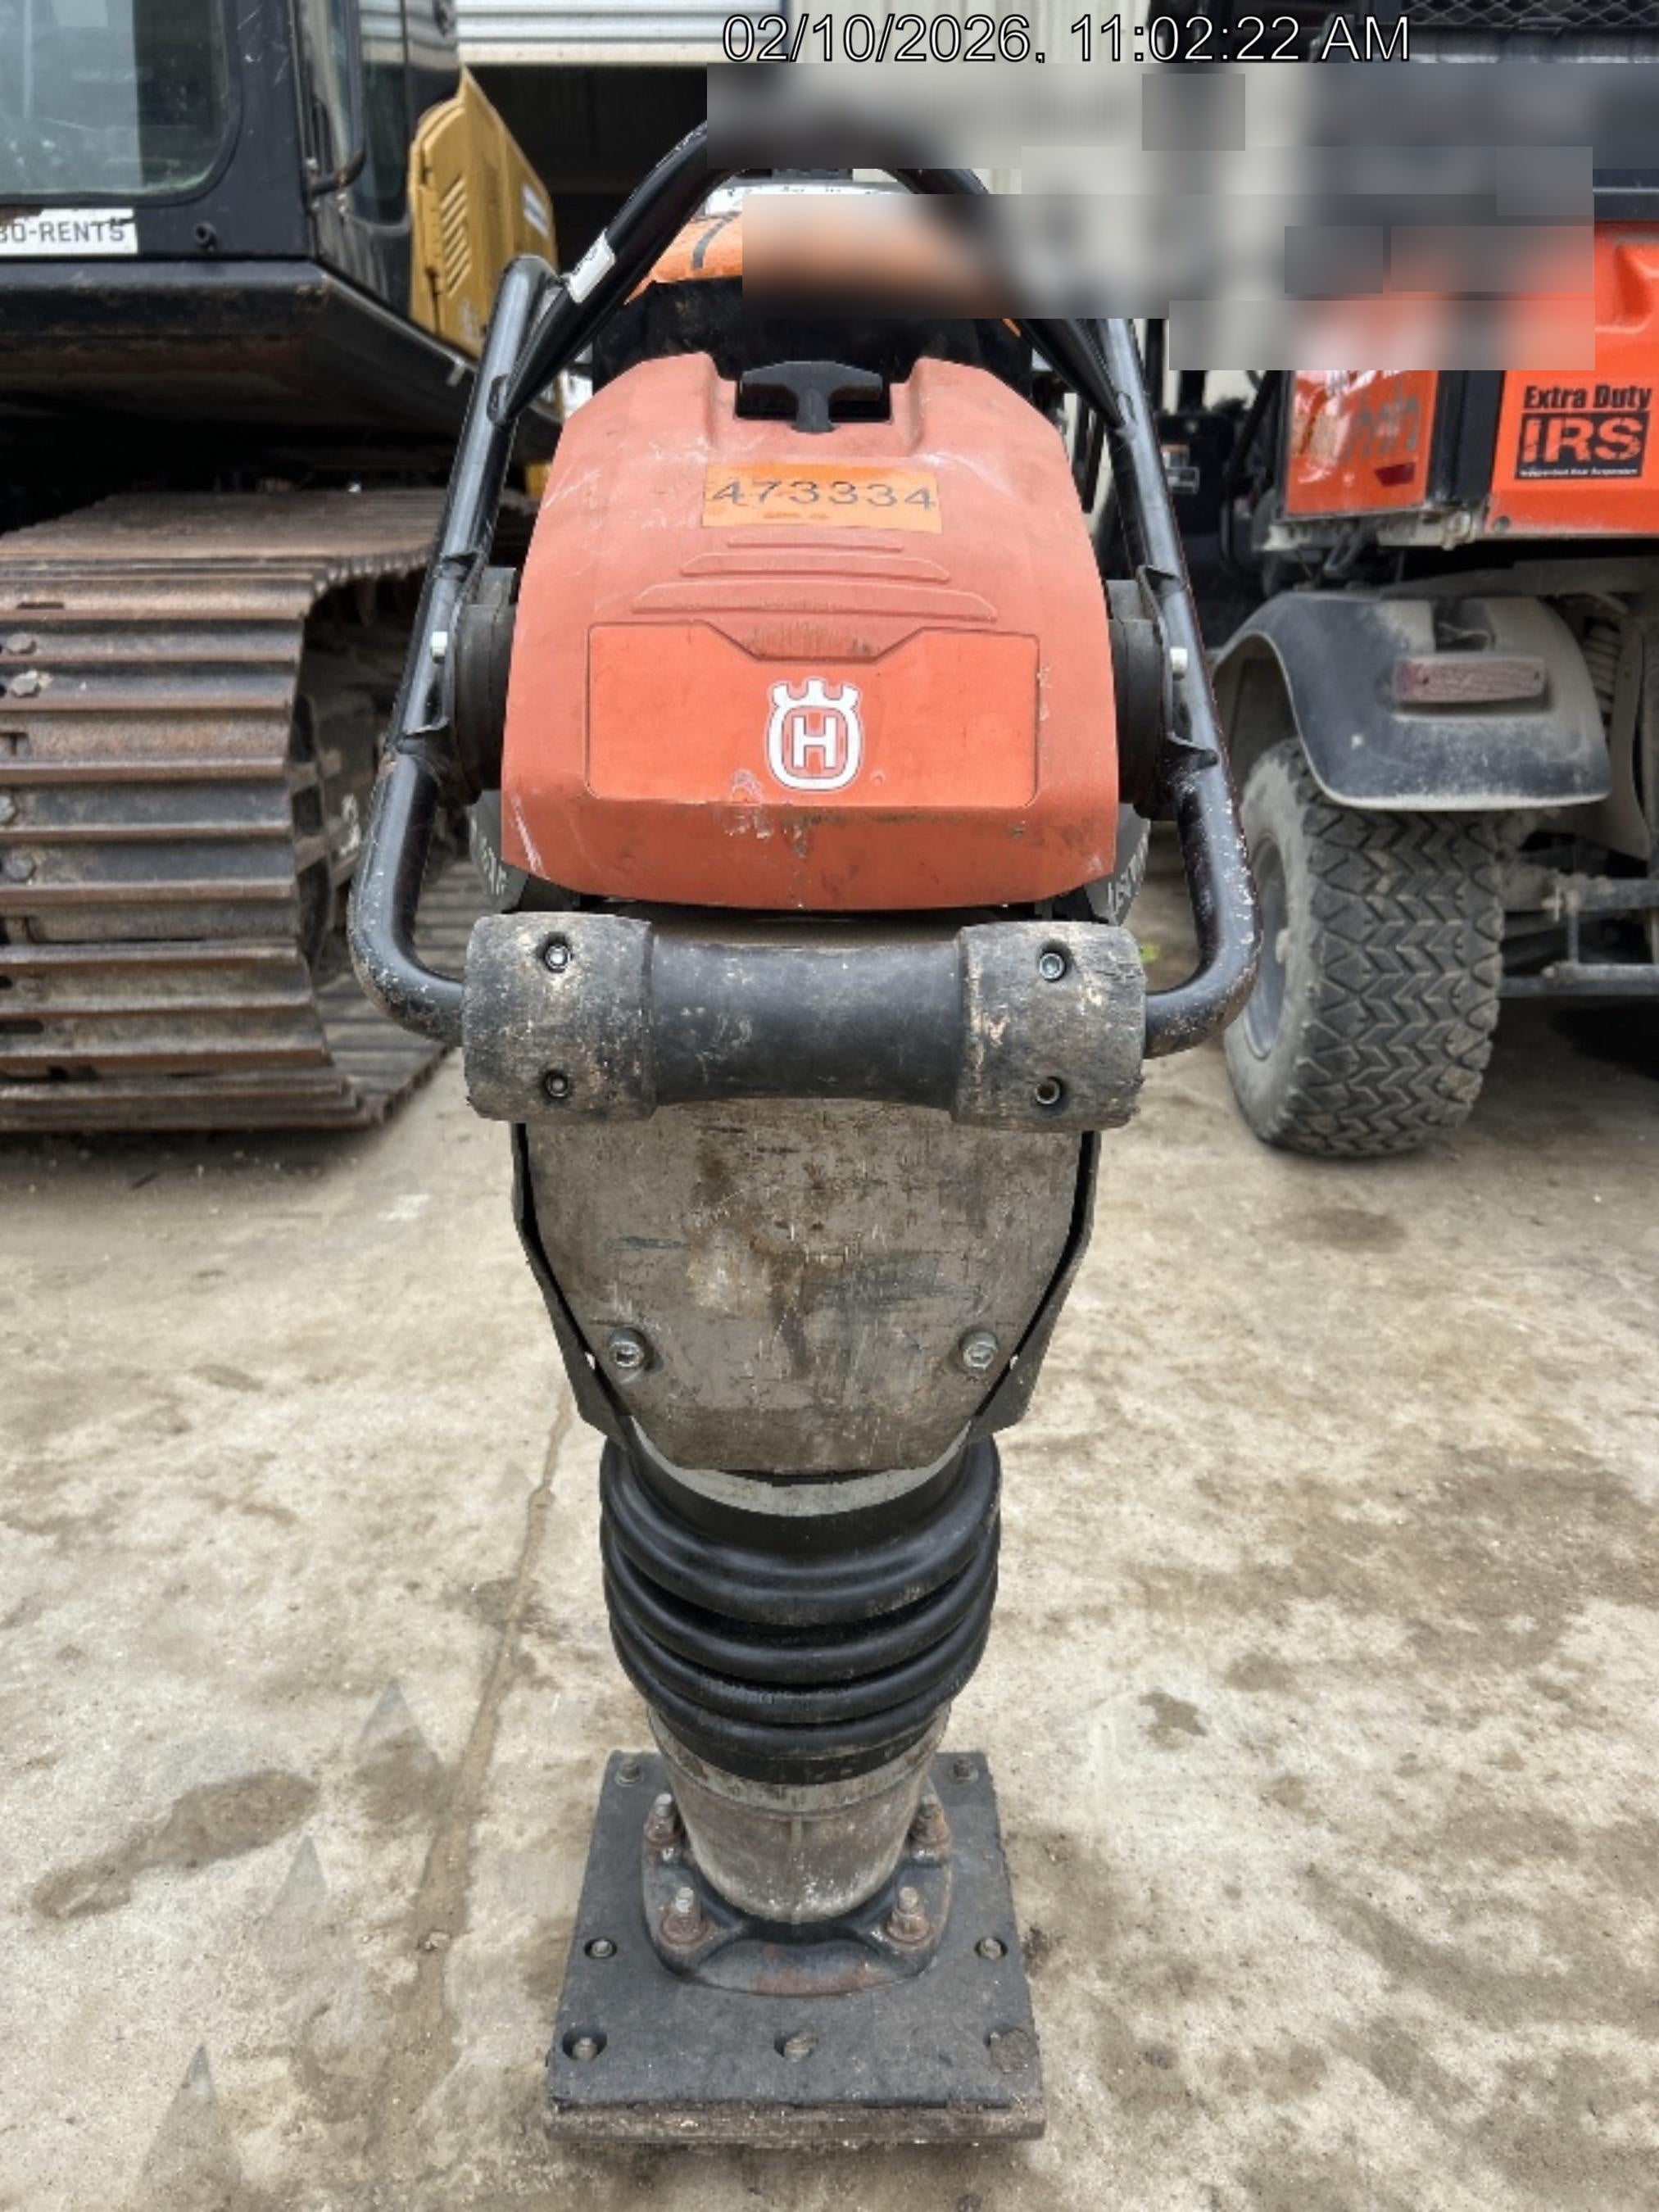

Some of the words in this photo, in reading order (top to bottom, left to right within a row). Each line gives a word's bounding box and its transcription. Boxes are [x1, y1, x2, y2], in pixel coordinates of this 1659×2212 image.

[1524, 386, 1587, 409] Extra
[1593, 385, 1652, 410] Duty
[1522, 416, 1643, 464] IRS
[712, 479, 936, 510] 473334
